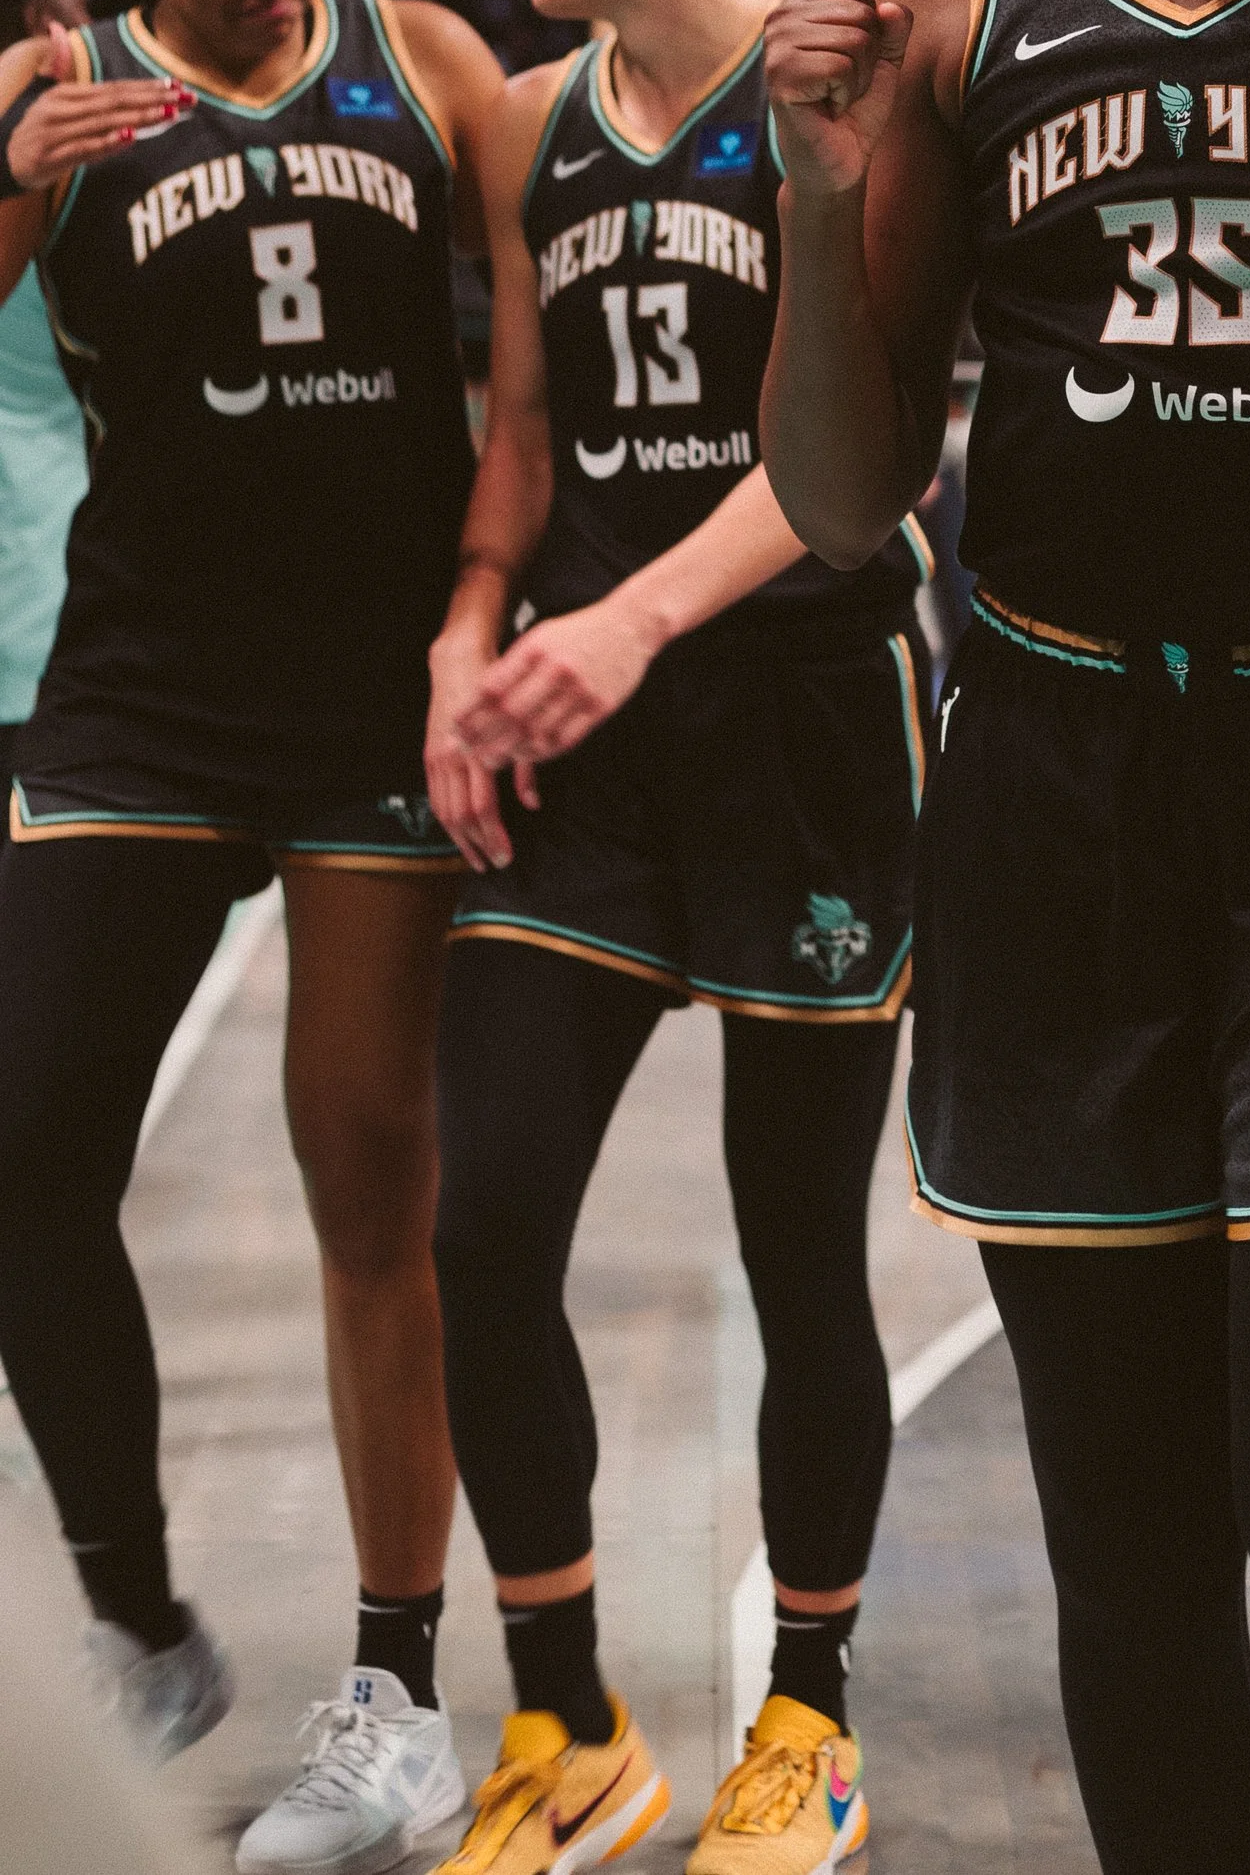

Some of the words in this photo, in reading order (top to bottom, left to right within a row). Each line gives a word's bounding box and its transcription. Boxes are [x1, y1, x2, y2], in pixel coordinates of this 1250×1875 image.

[127, 152, 246, 268] NEW
[280, 143, 420, 234] YORK
[1008, 88, 1147, 228] NEW
[249, 220, 326, 346] 8
[539, 205, 628, 310] NEW
[654, 198, 769, 294] YORK
[280, 367, 398, 408] Webull
[602, 281, 702, 408] 13
[634, 428, 753, 472] Webull
